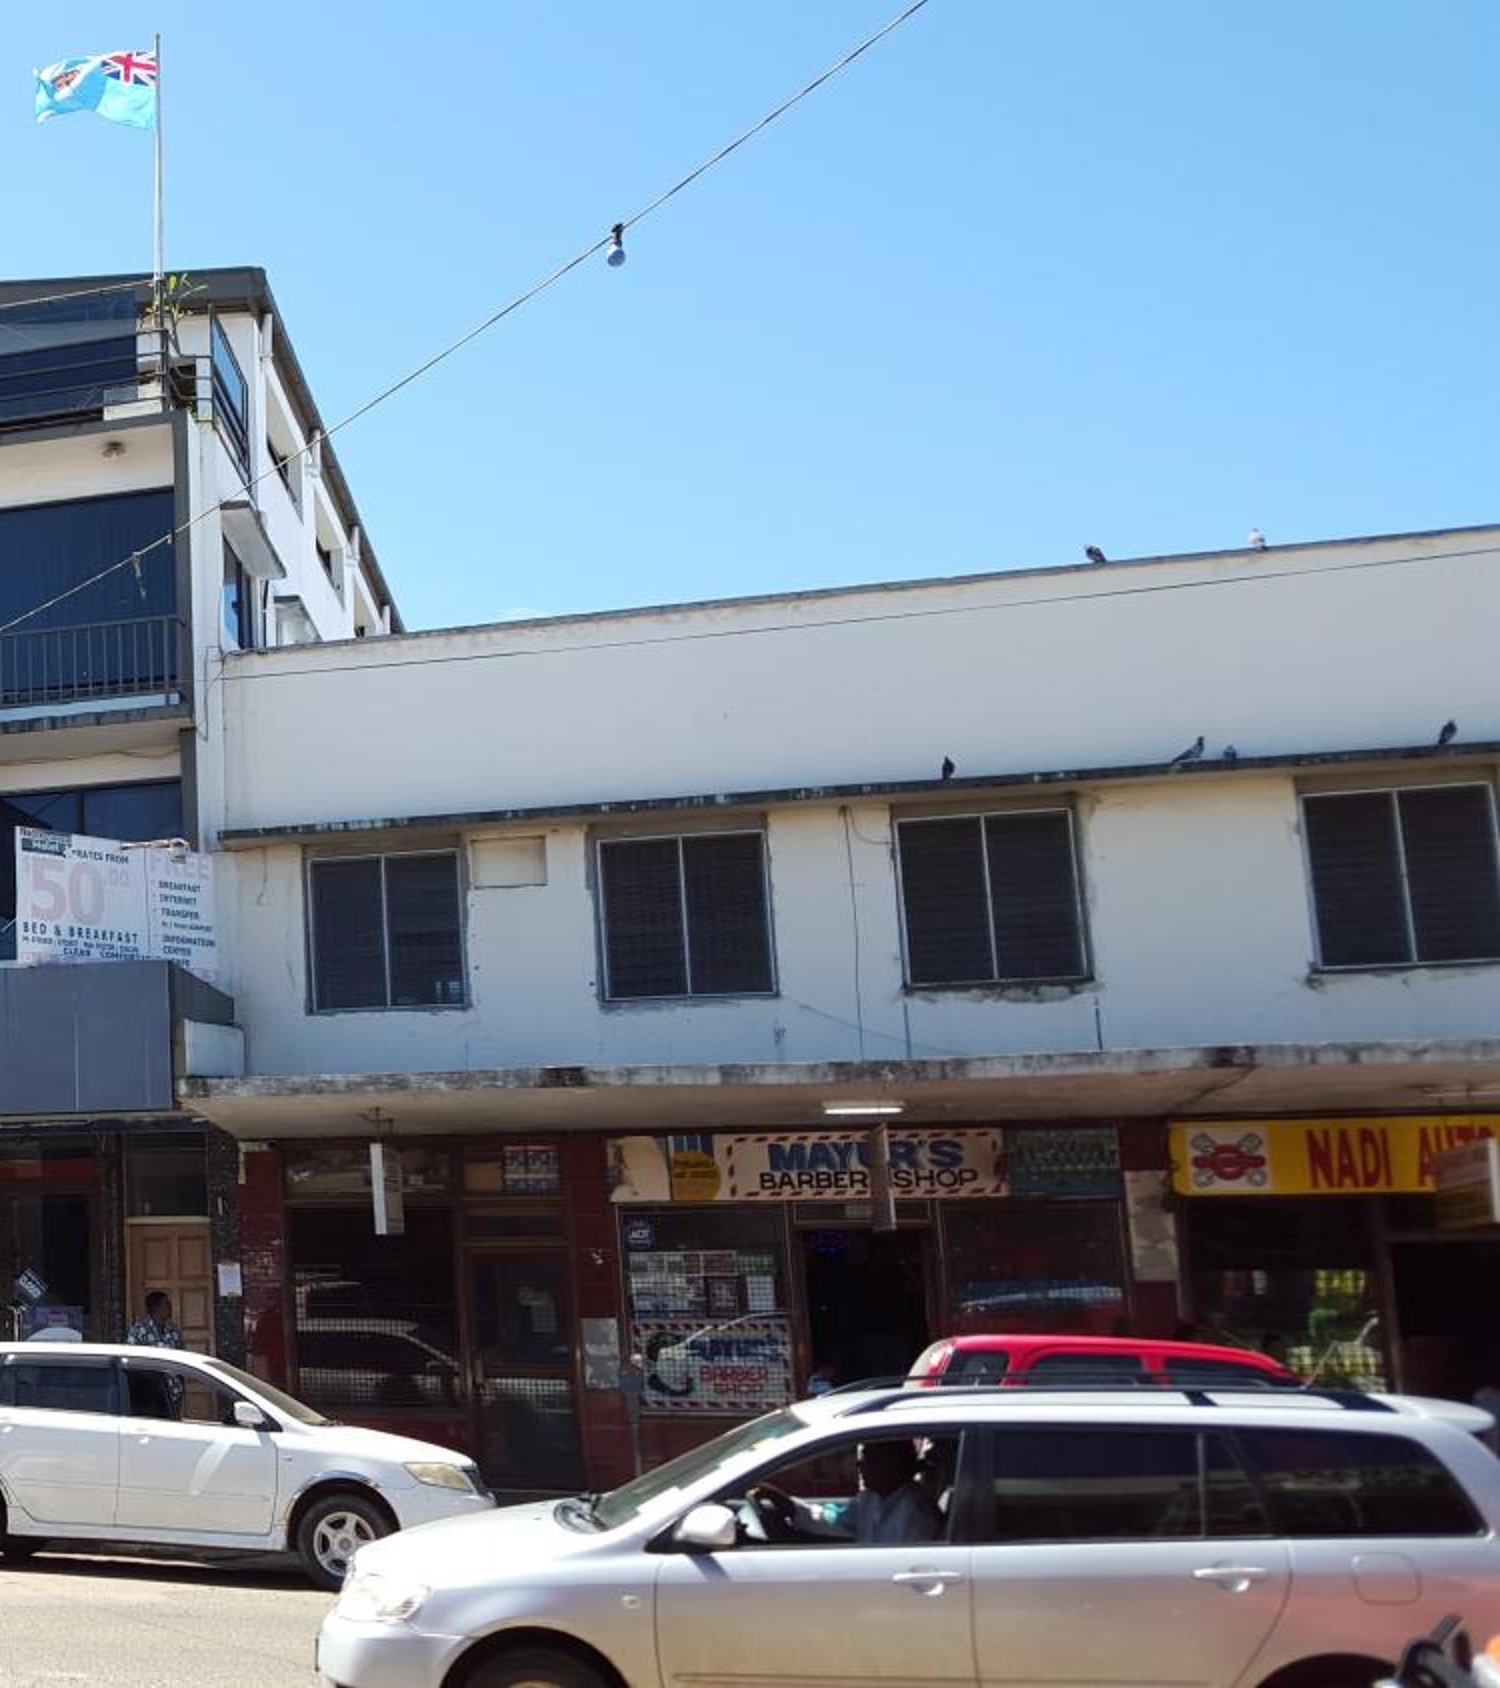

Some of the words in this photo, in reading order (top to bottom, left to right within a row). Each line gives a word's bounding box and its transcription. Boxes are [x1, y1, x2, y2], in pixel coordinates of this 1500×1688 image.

[105, 853, 129, 864] FROM
[161, 908, 199, 920] TRANSFER
[23, 922, 47, 935] BED
[69, 926, 138, 944] BREAKFAST
[1305, 1126, 1393, 1188] NADI
[759, 1170, 868, 1190] BARBER
[893, 1168, 979, 1189] SHOP
[699, 1366, 768, 1383] BARBER
